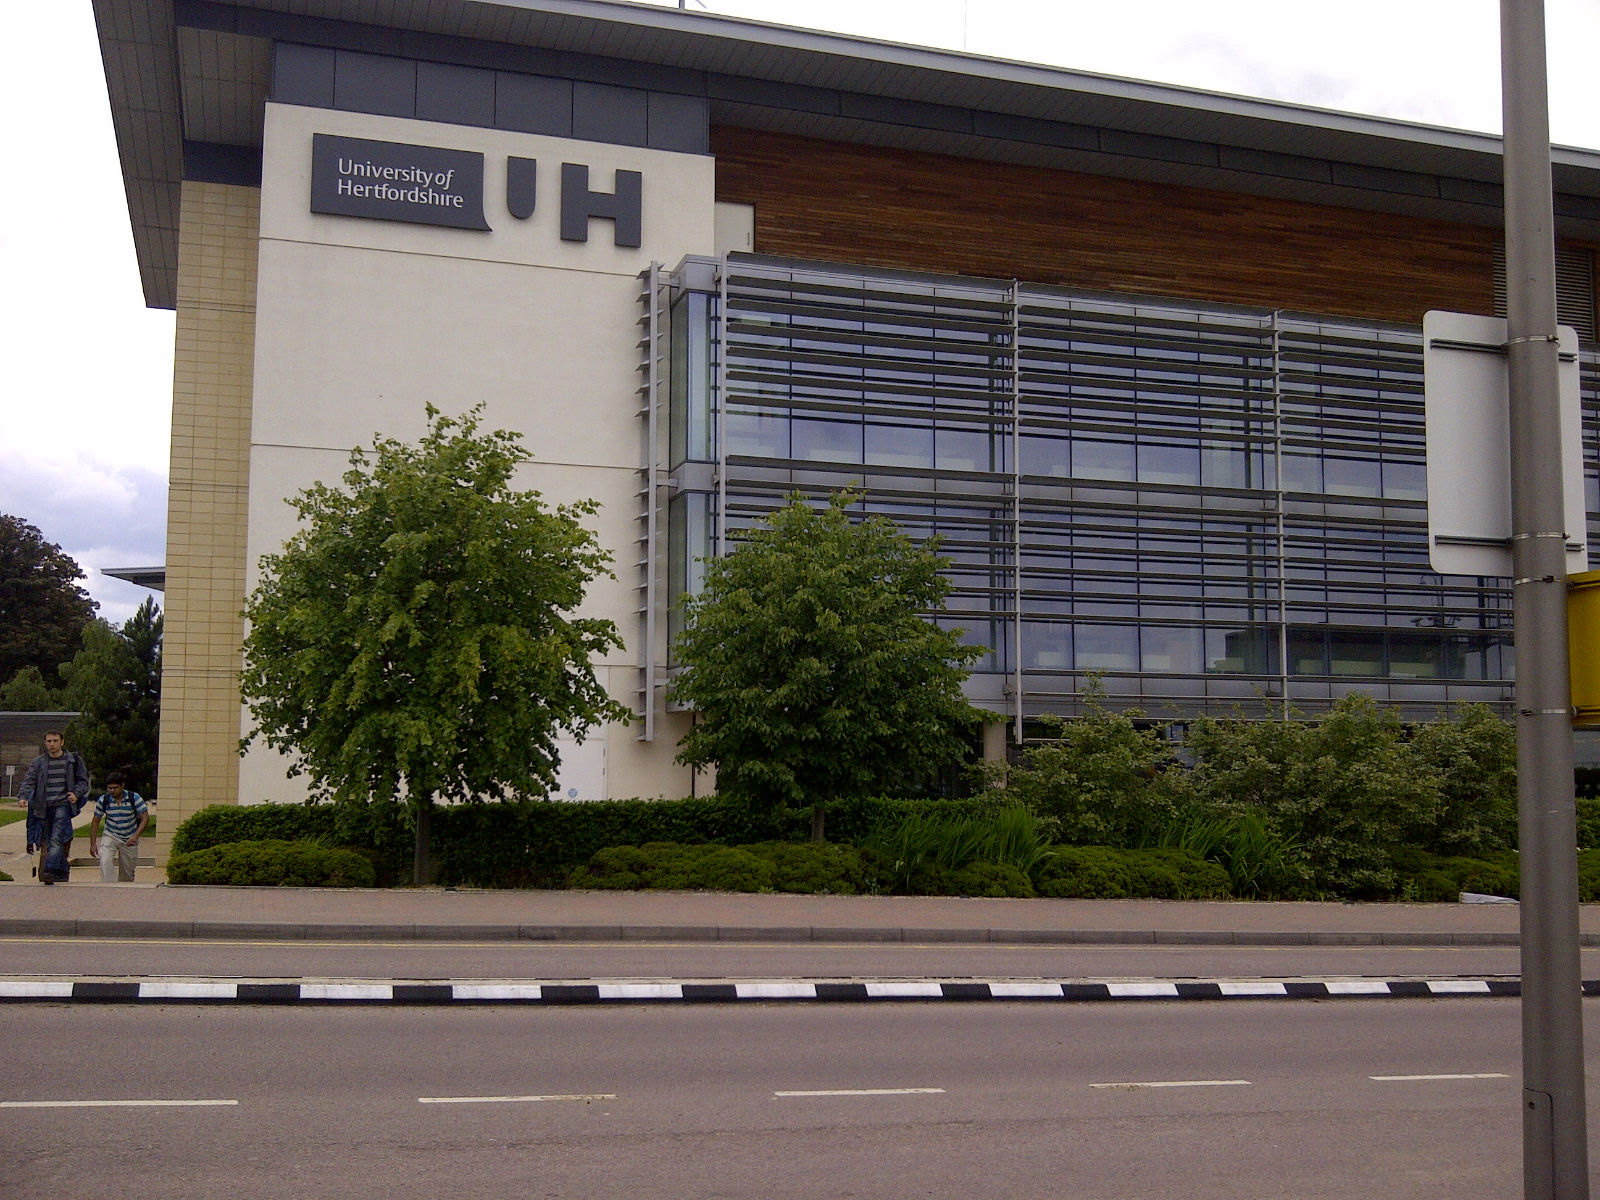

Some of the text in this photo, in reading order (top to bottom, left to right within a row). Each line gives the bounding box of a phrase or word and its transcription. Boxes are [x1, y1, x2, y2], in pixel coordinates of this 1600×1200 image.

[338, 157, 455, 190] University of
[338, 179, 464, 208] Hertfordshire
